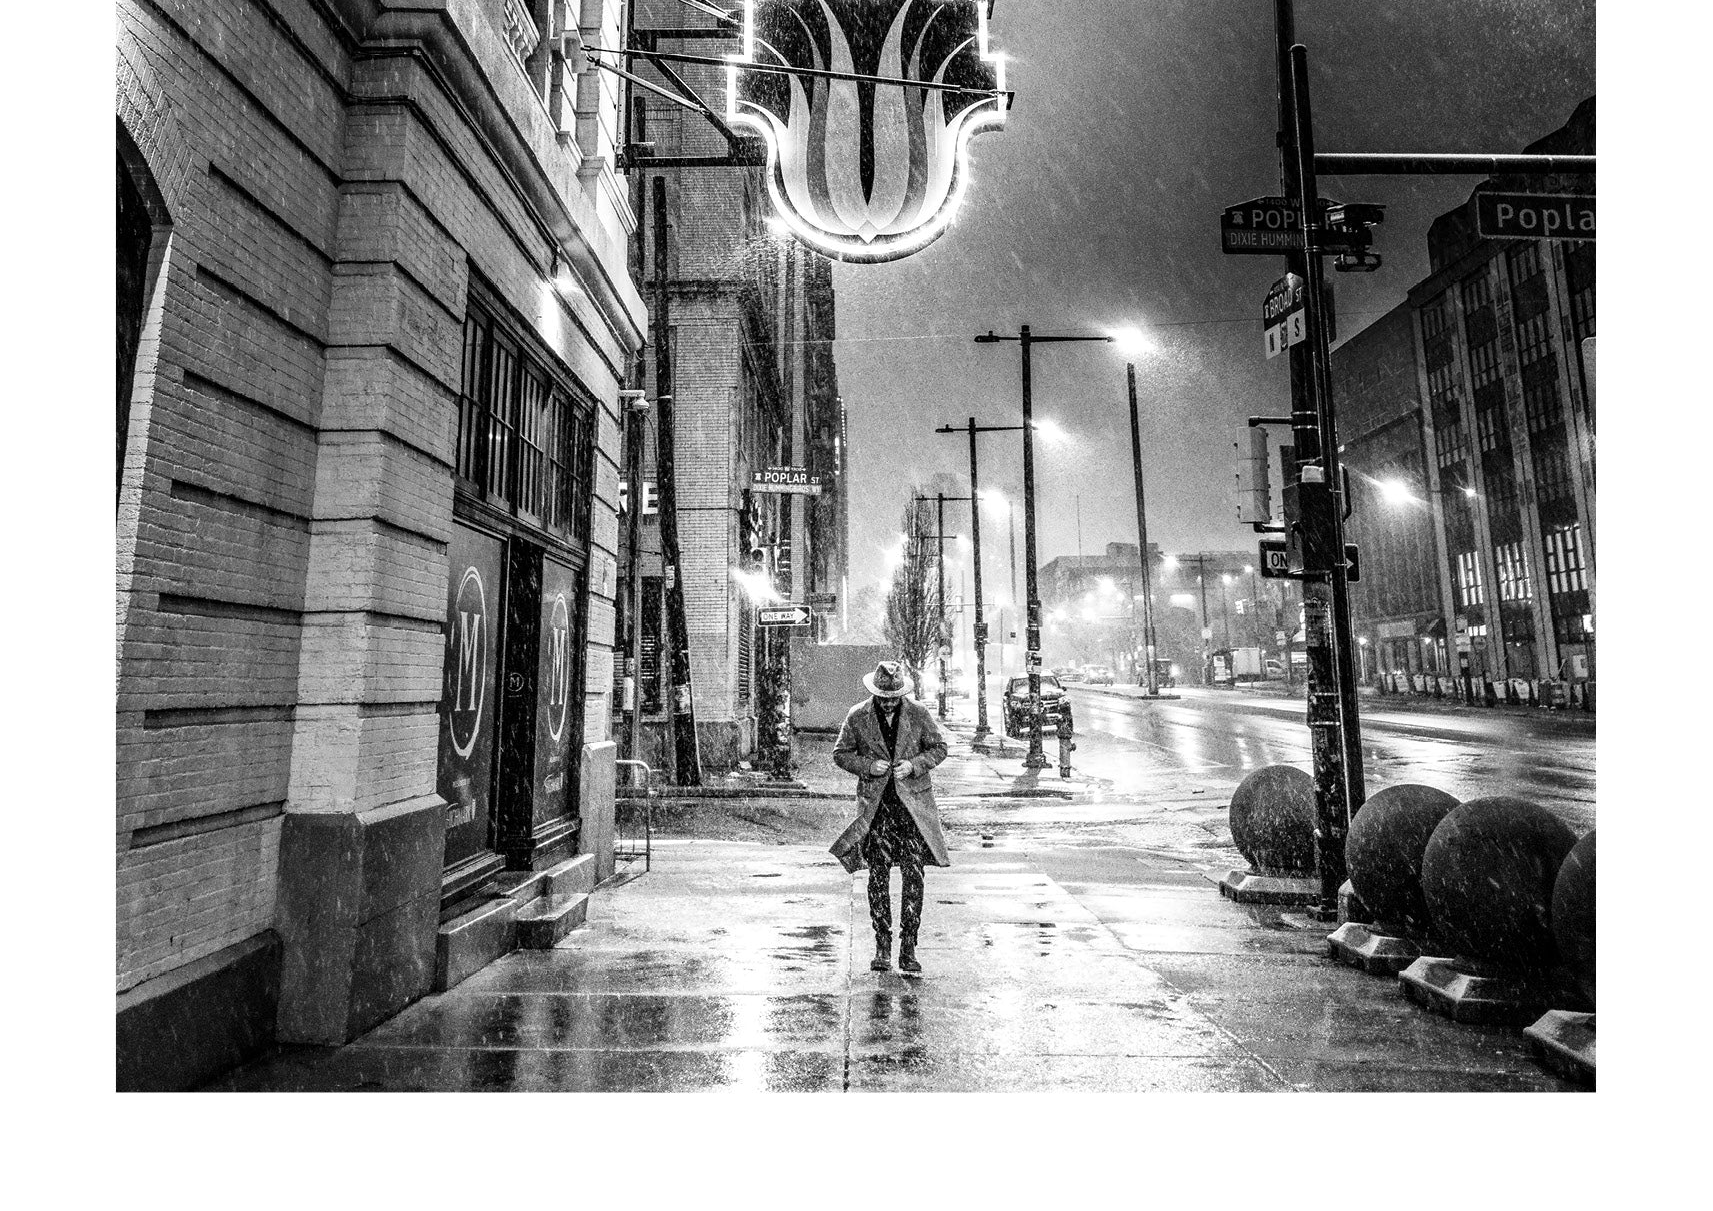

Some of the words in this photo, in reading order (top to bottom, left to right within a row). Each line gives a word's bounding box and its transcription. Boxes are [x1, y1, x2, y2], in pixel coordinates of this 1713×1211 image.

[1497, 204, 1596, 236] Popla
[1230, 233, 1257, 246] DIXIE
[1261, 233, 1305, 247] HUMMIN
[1270, 287, 1293, 318] BROAD
[1295, 317, 1300, 337] S
[764, 472, 807, 484] POPLAR
[811, 476, 820, 484] ST
[1271, 552, 1288, 567] ON
[763, 612, 778, 620] ONE
[780, 612, 795, 620] WAY
[454, 611, 481, 712] M
[549, 626, 566, 706] M
